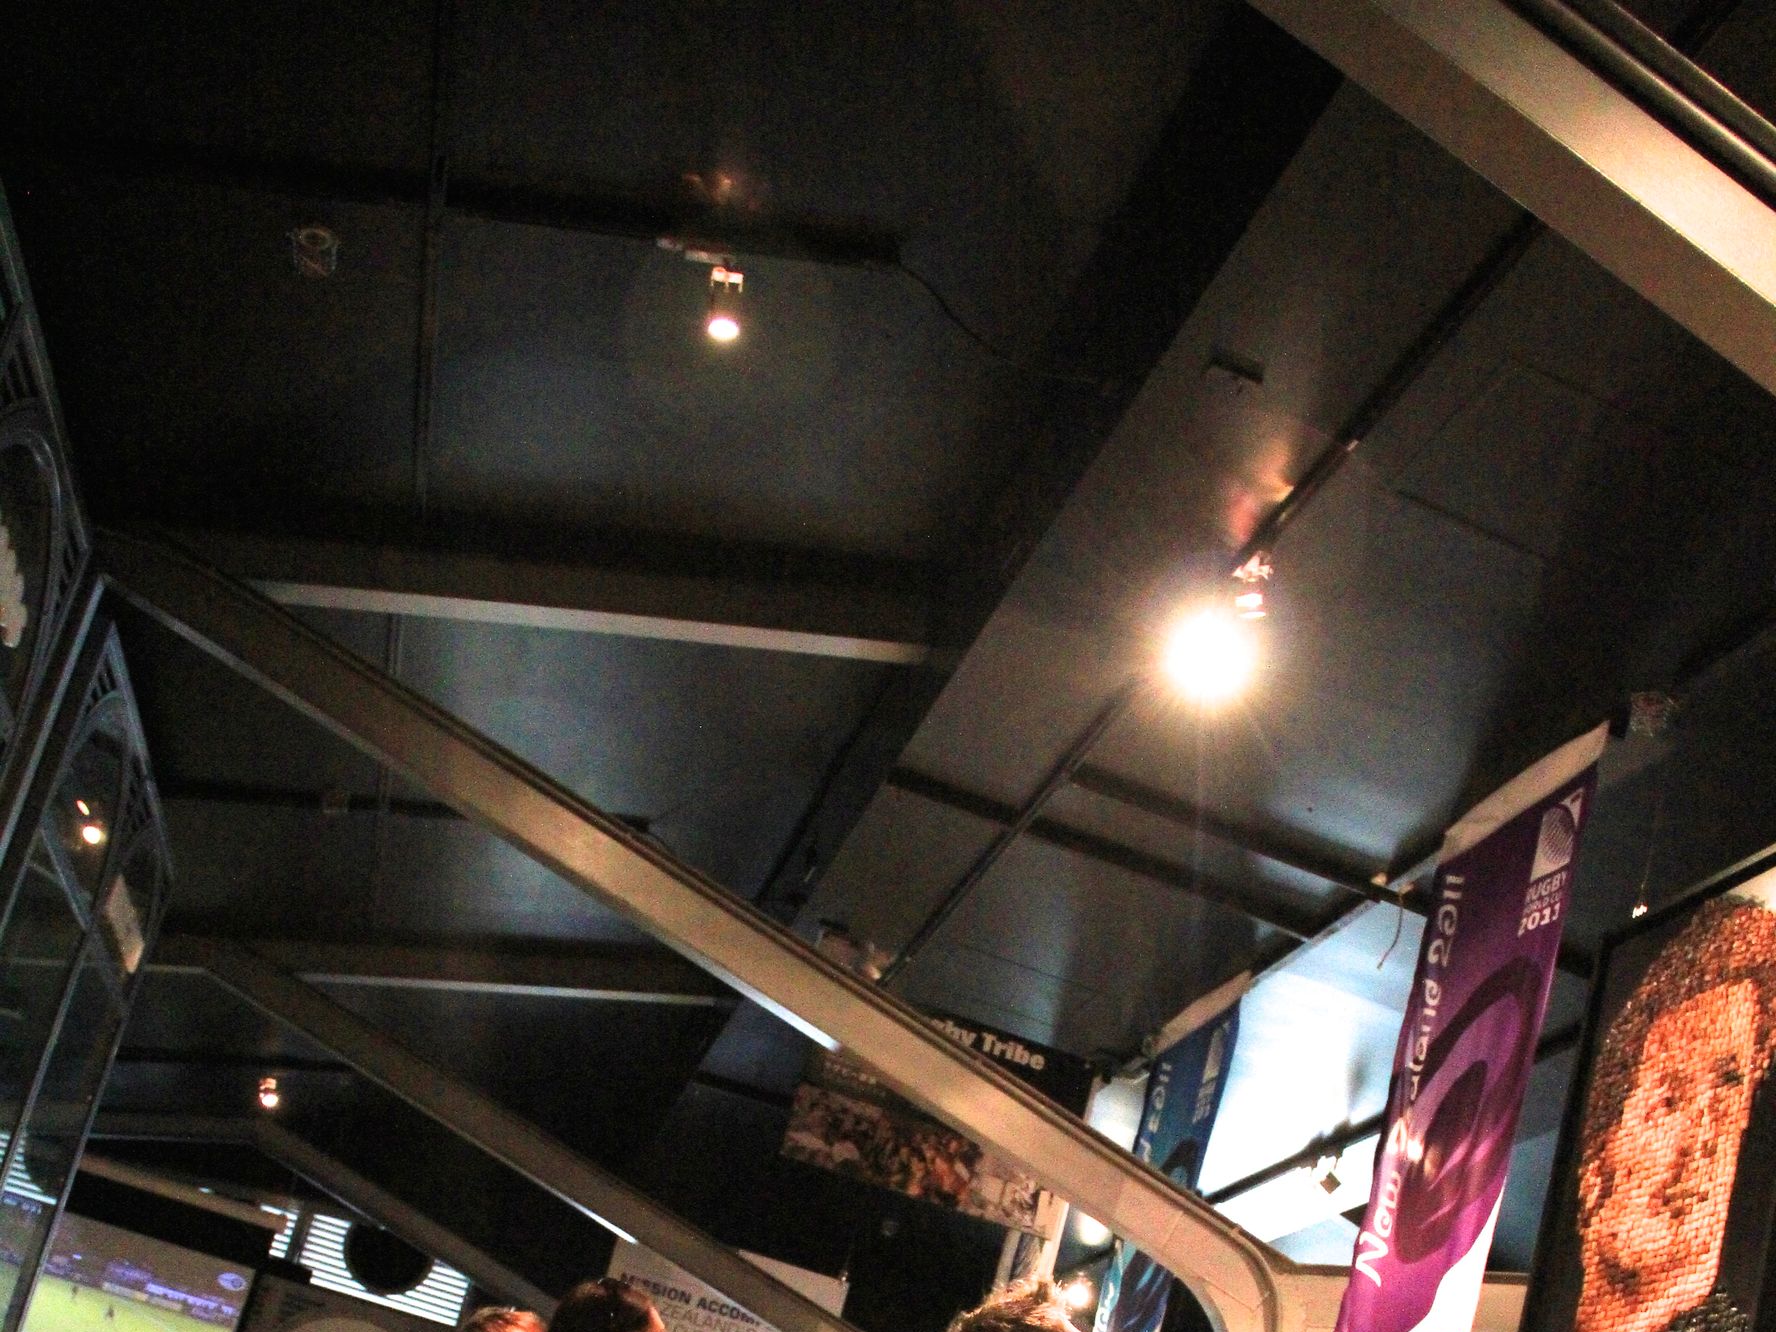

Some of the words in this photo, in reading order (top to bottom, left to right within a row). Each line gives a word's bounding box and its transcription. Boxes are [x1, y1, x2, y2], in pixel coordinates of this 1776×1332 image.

[1517, 901, 1561, 939] 2011
[982, 1031, 1046, 1071] Tribe
[1355, 1171, 1402, 1288] New
[1427, 874, 1465, 968] 2011
